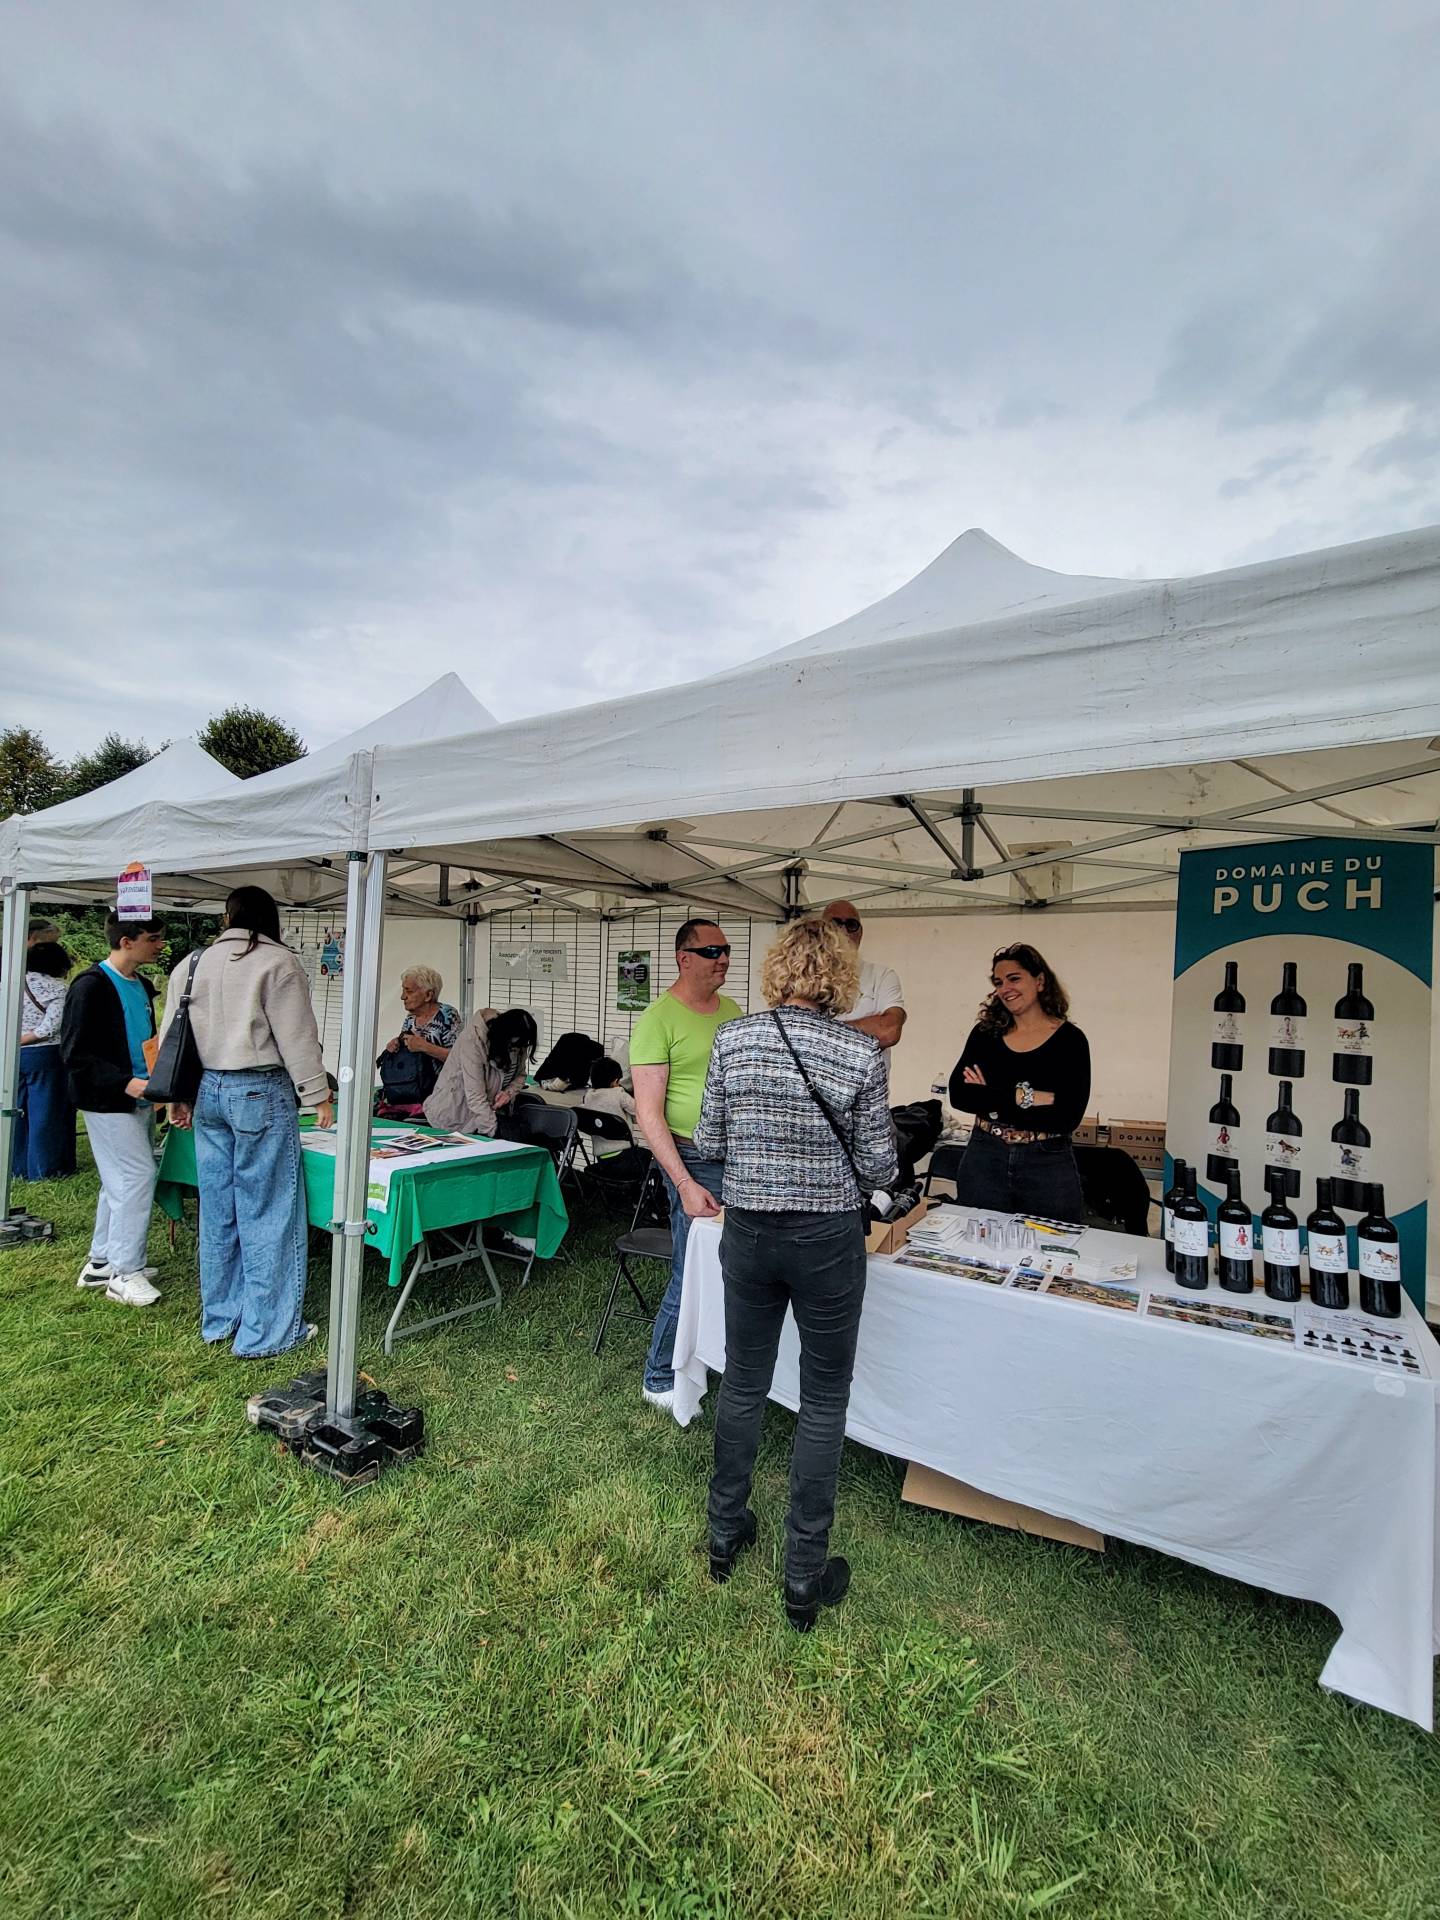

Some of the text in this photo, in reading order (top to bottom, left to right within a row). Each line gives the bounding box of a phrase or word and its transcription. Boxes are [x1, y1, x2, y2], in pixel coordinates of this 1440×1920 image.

[1215, 855, 1382, 881] DOMAINE DU
[1212, 877, 1383, 915] PUCH
[1119, 1134, 1164, 1143] DOMAIN
[1132, 1154, 1161, 1162] MAIN
